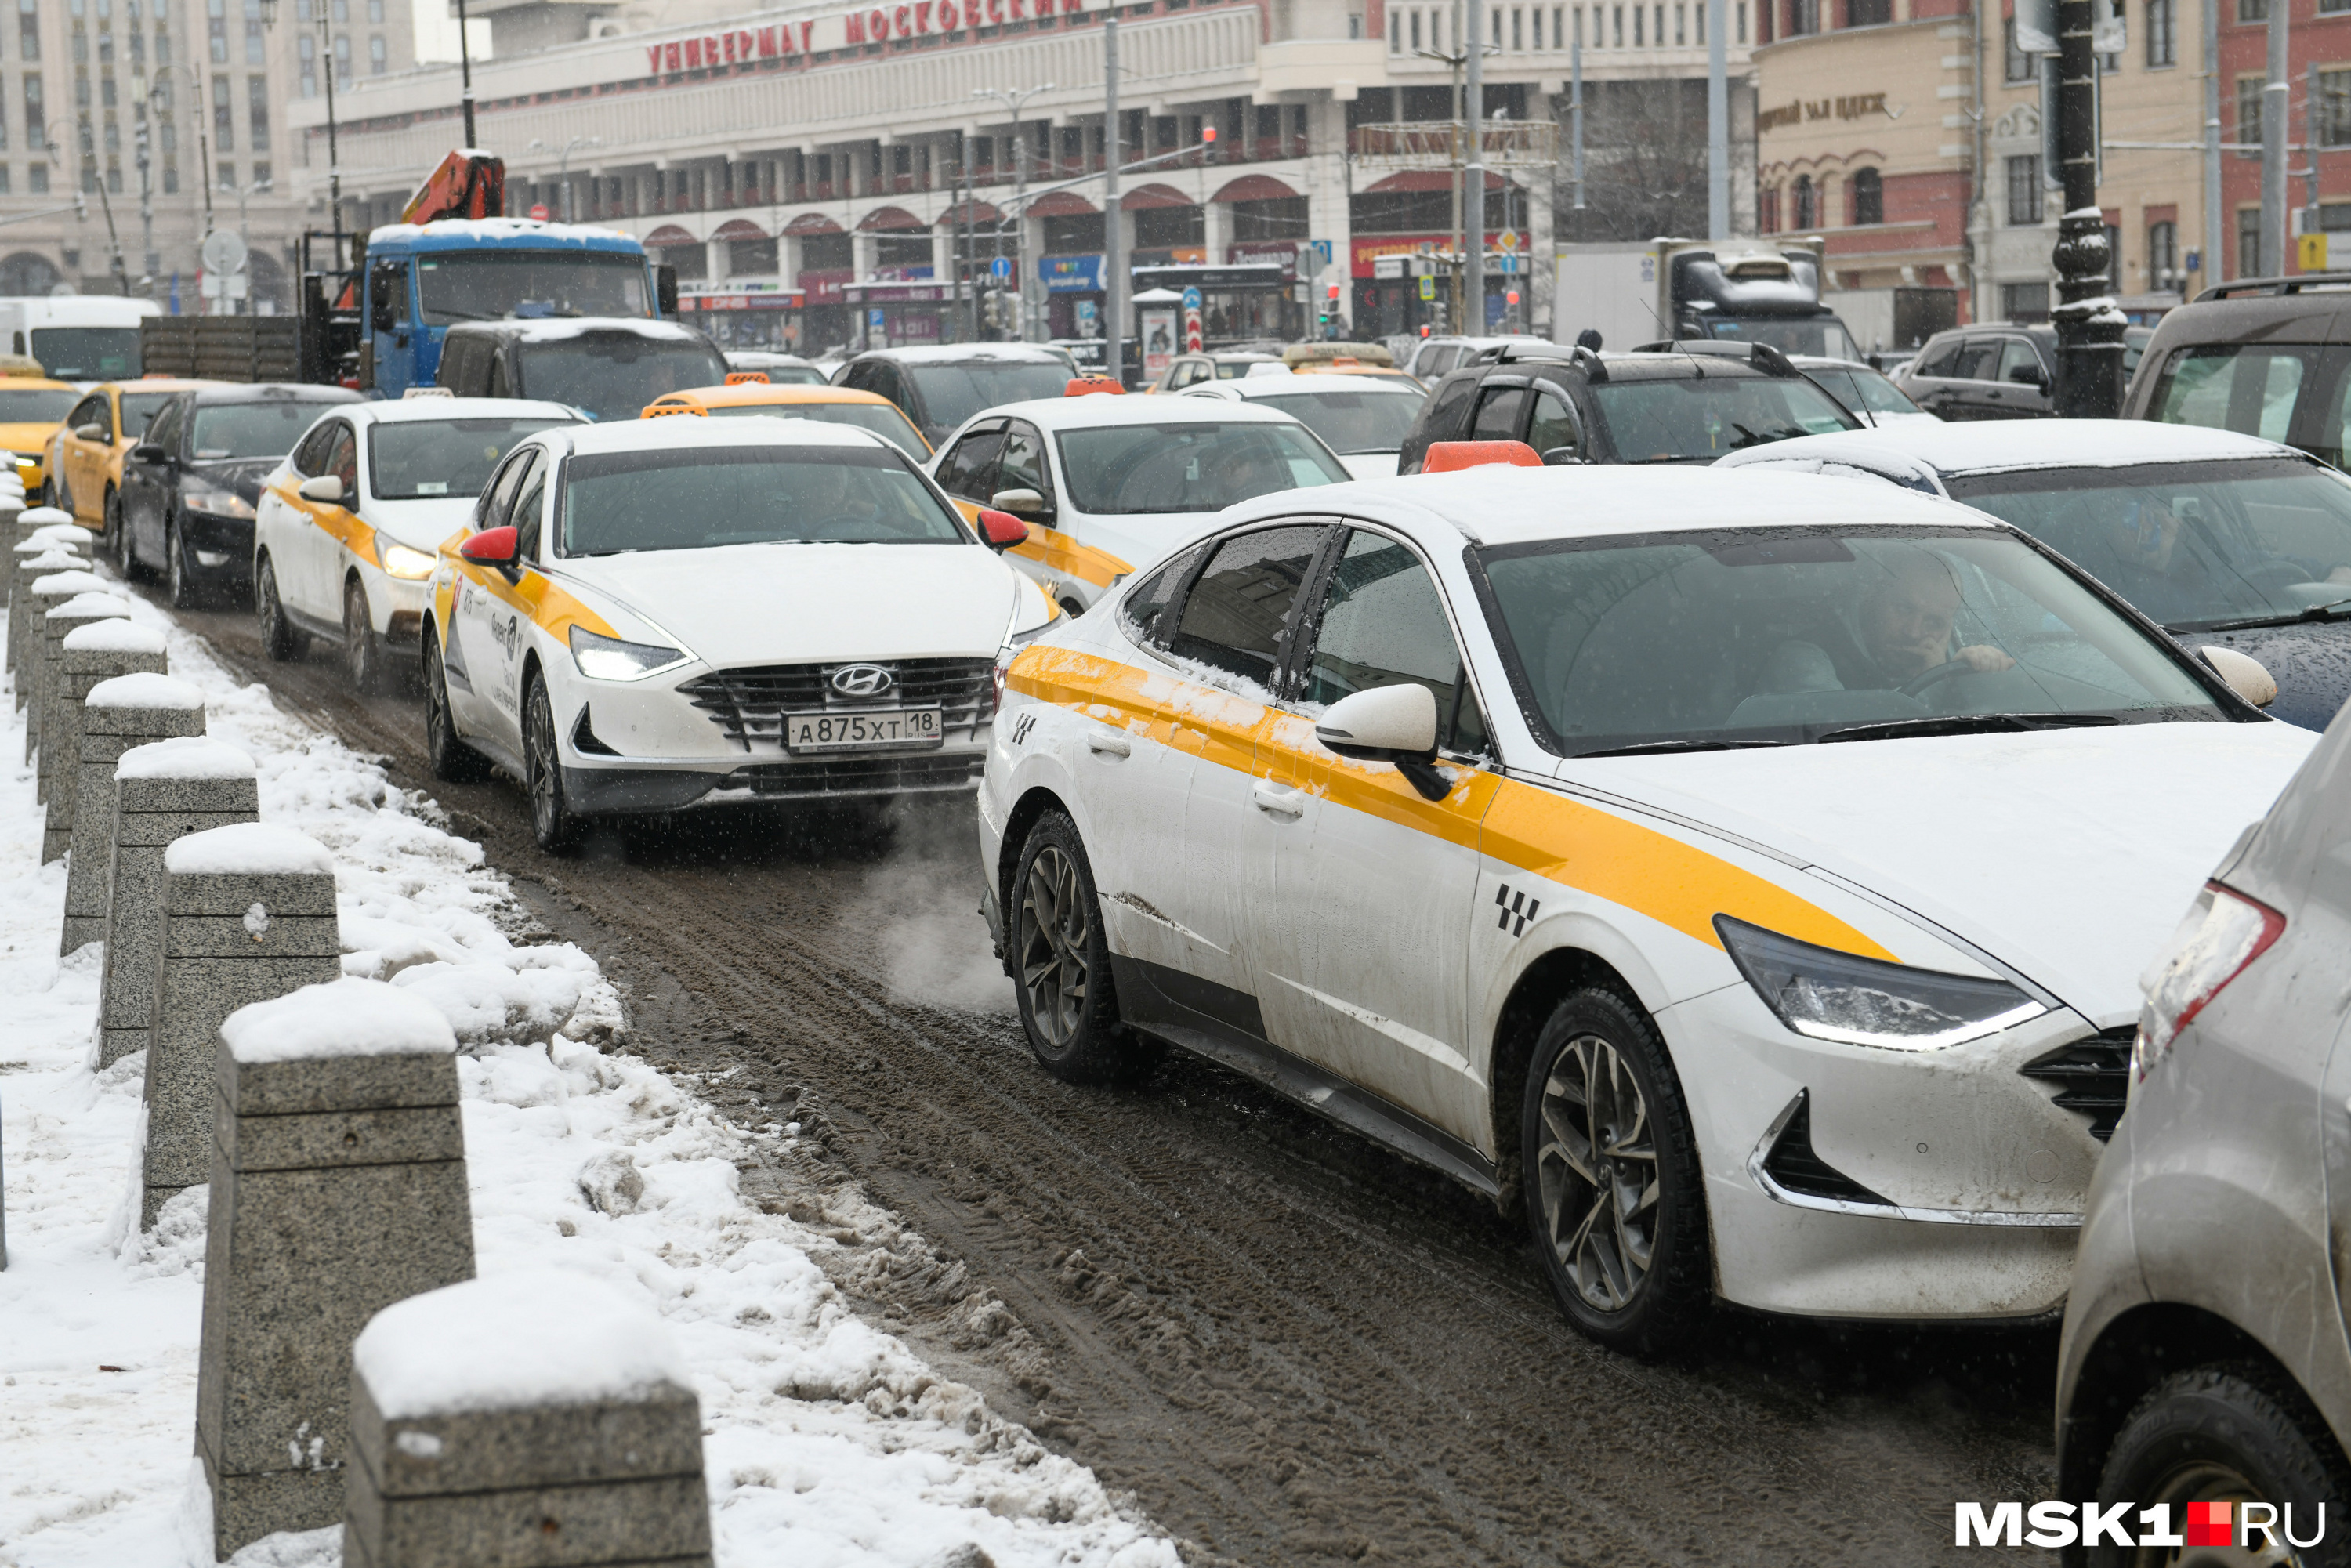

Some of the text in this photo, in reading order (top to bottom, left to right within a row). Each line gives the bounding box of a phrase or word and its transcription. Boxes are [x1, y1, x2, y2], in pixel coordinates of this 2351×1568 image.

[647, 20, 814, 74] УНИВЕРМАГ
[799, 716, 900, 744] А875ХТ
[910, 712, 933, 731] 18
